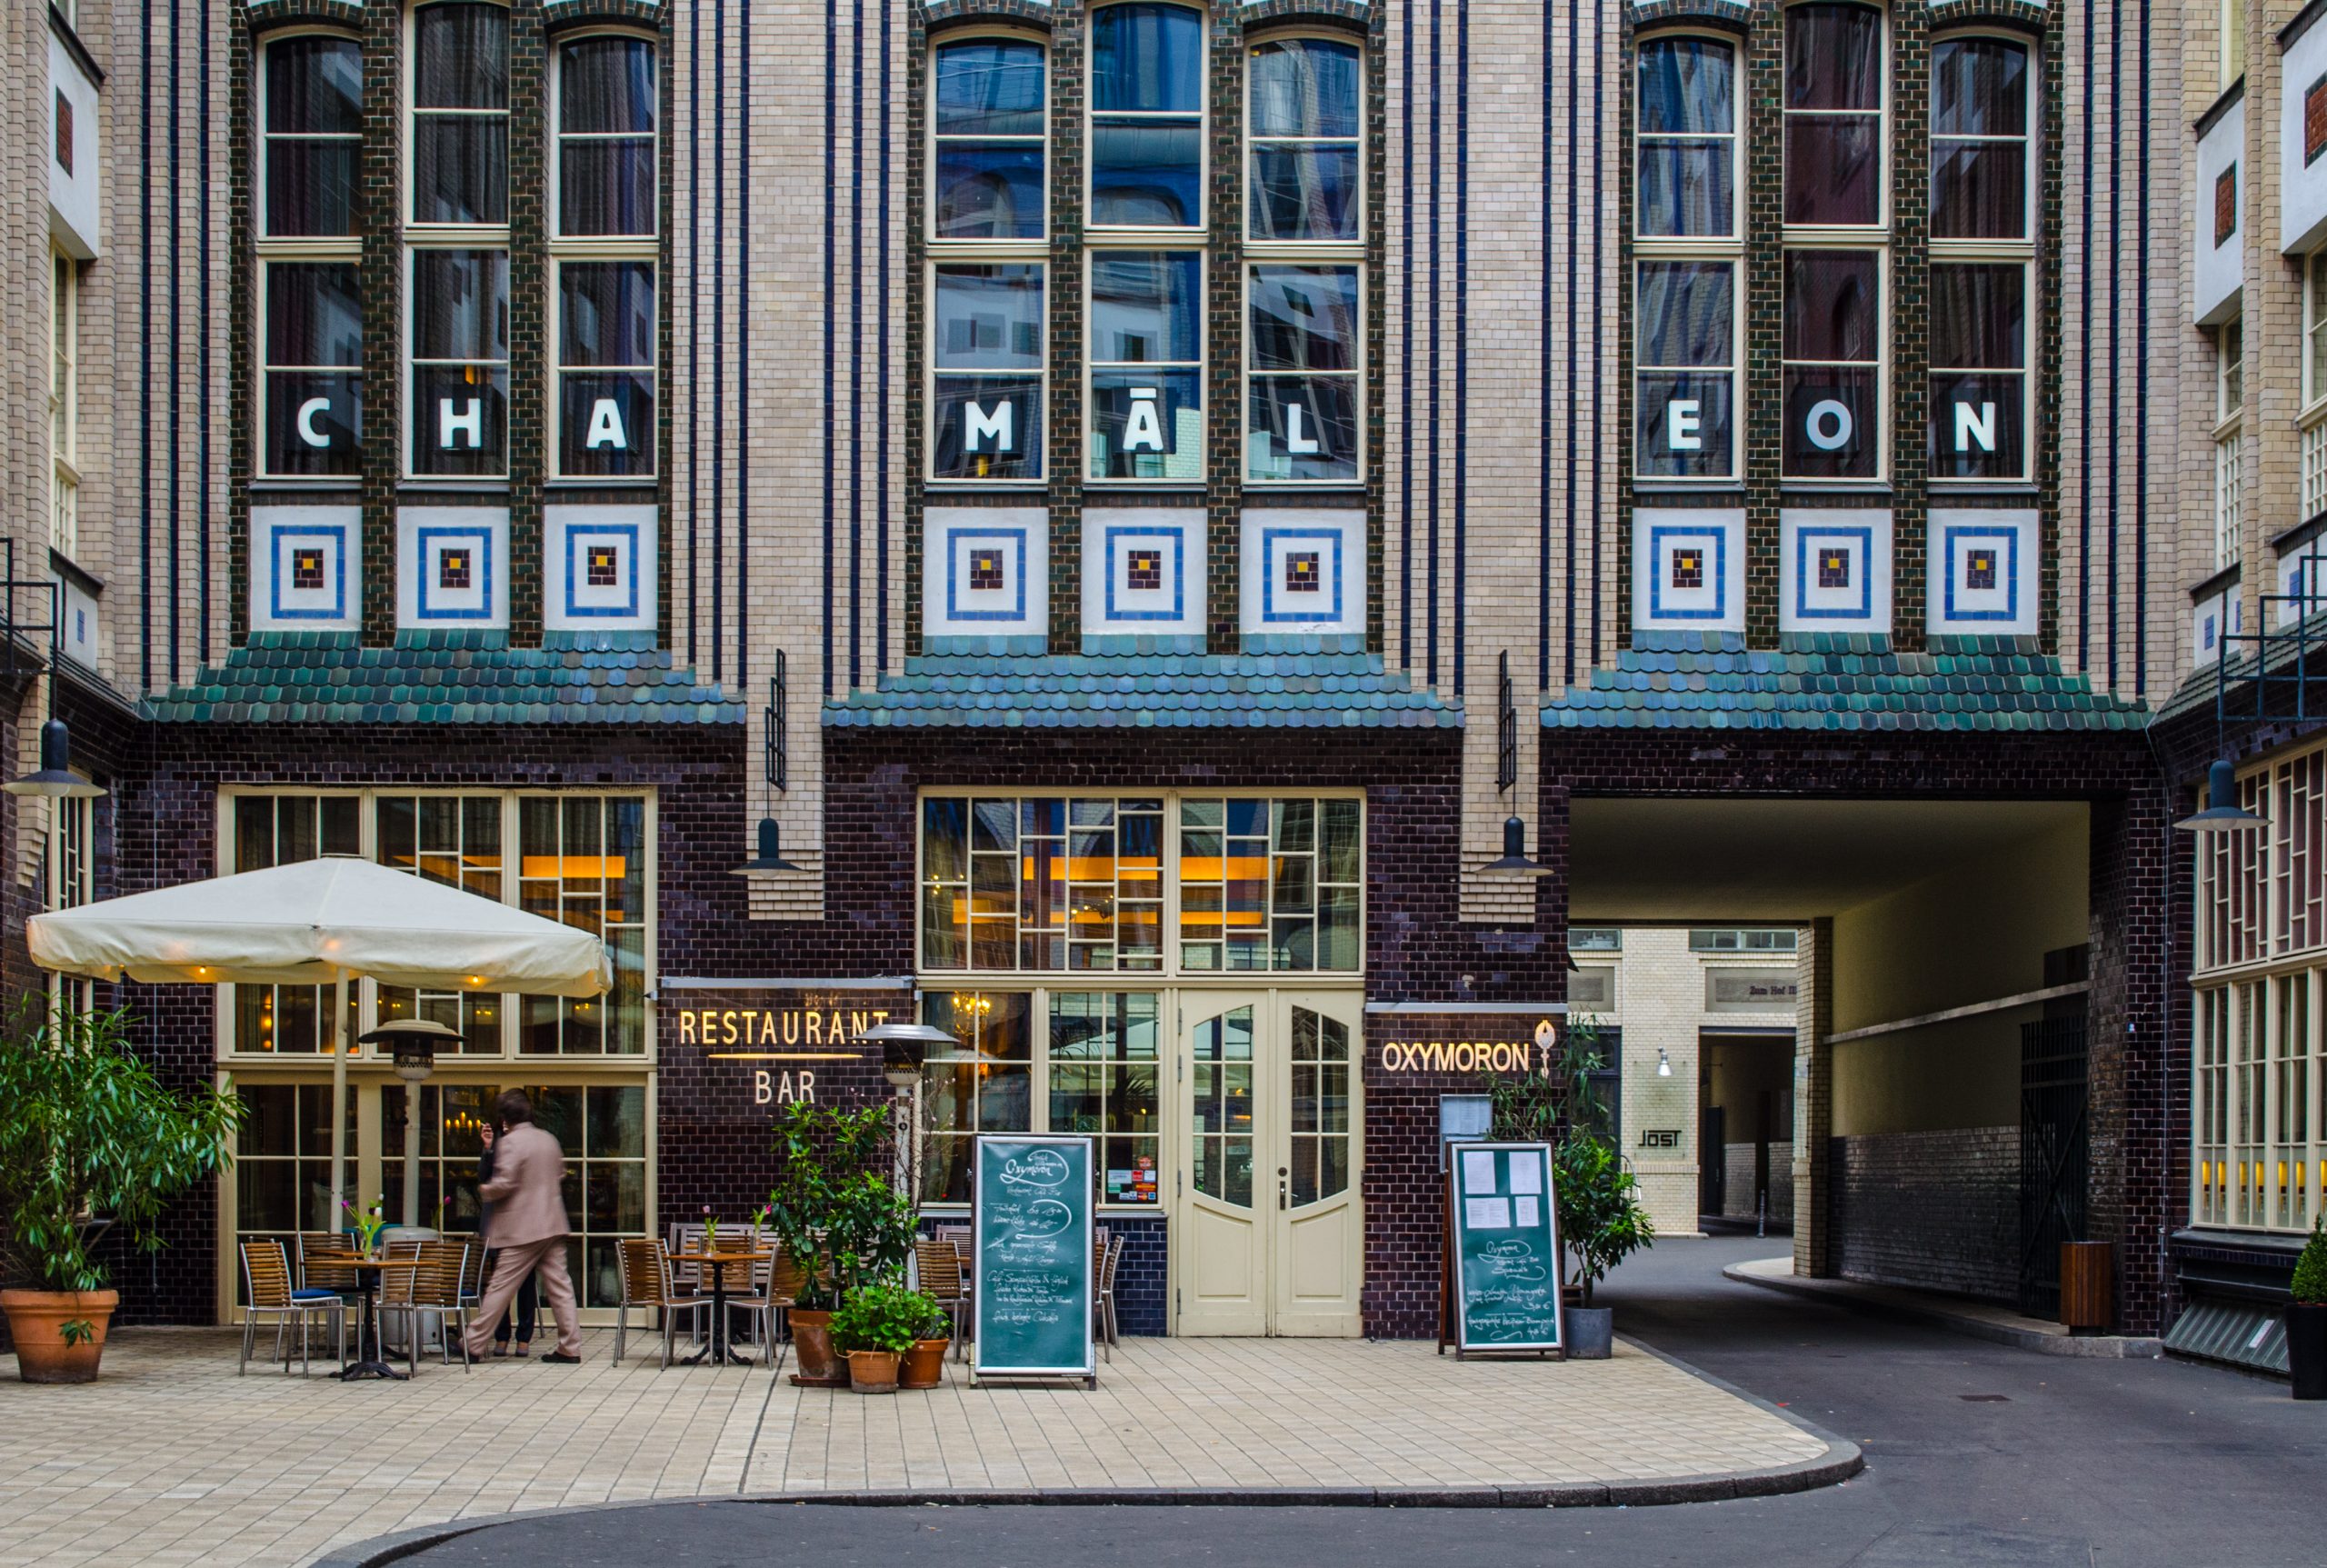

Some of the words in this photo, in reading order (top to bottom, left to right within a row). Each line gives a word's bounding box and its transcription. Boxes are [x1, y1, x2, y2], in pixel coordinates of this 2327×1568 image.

[1750, 985, 1768, 995] Zum
[1771, 985, 1786, 995] Hof
[1382, 1042, 1530, 1072] OXYMORON
[755, 1070, 815, 1104] BAR
